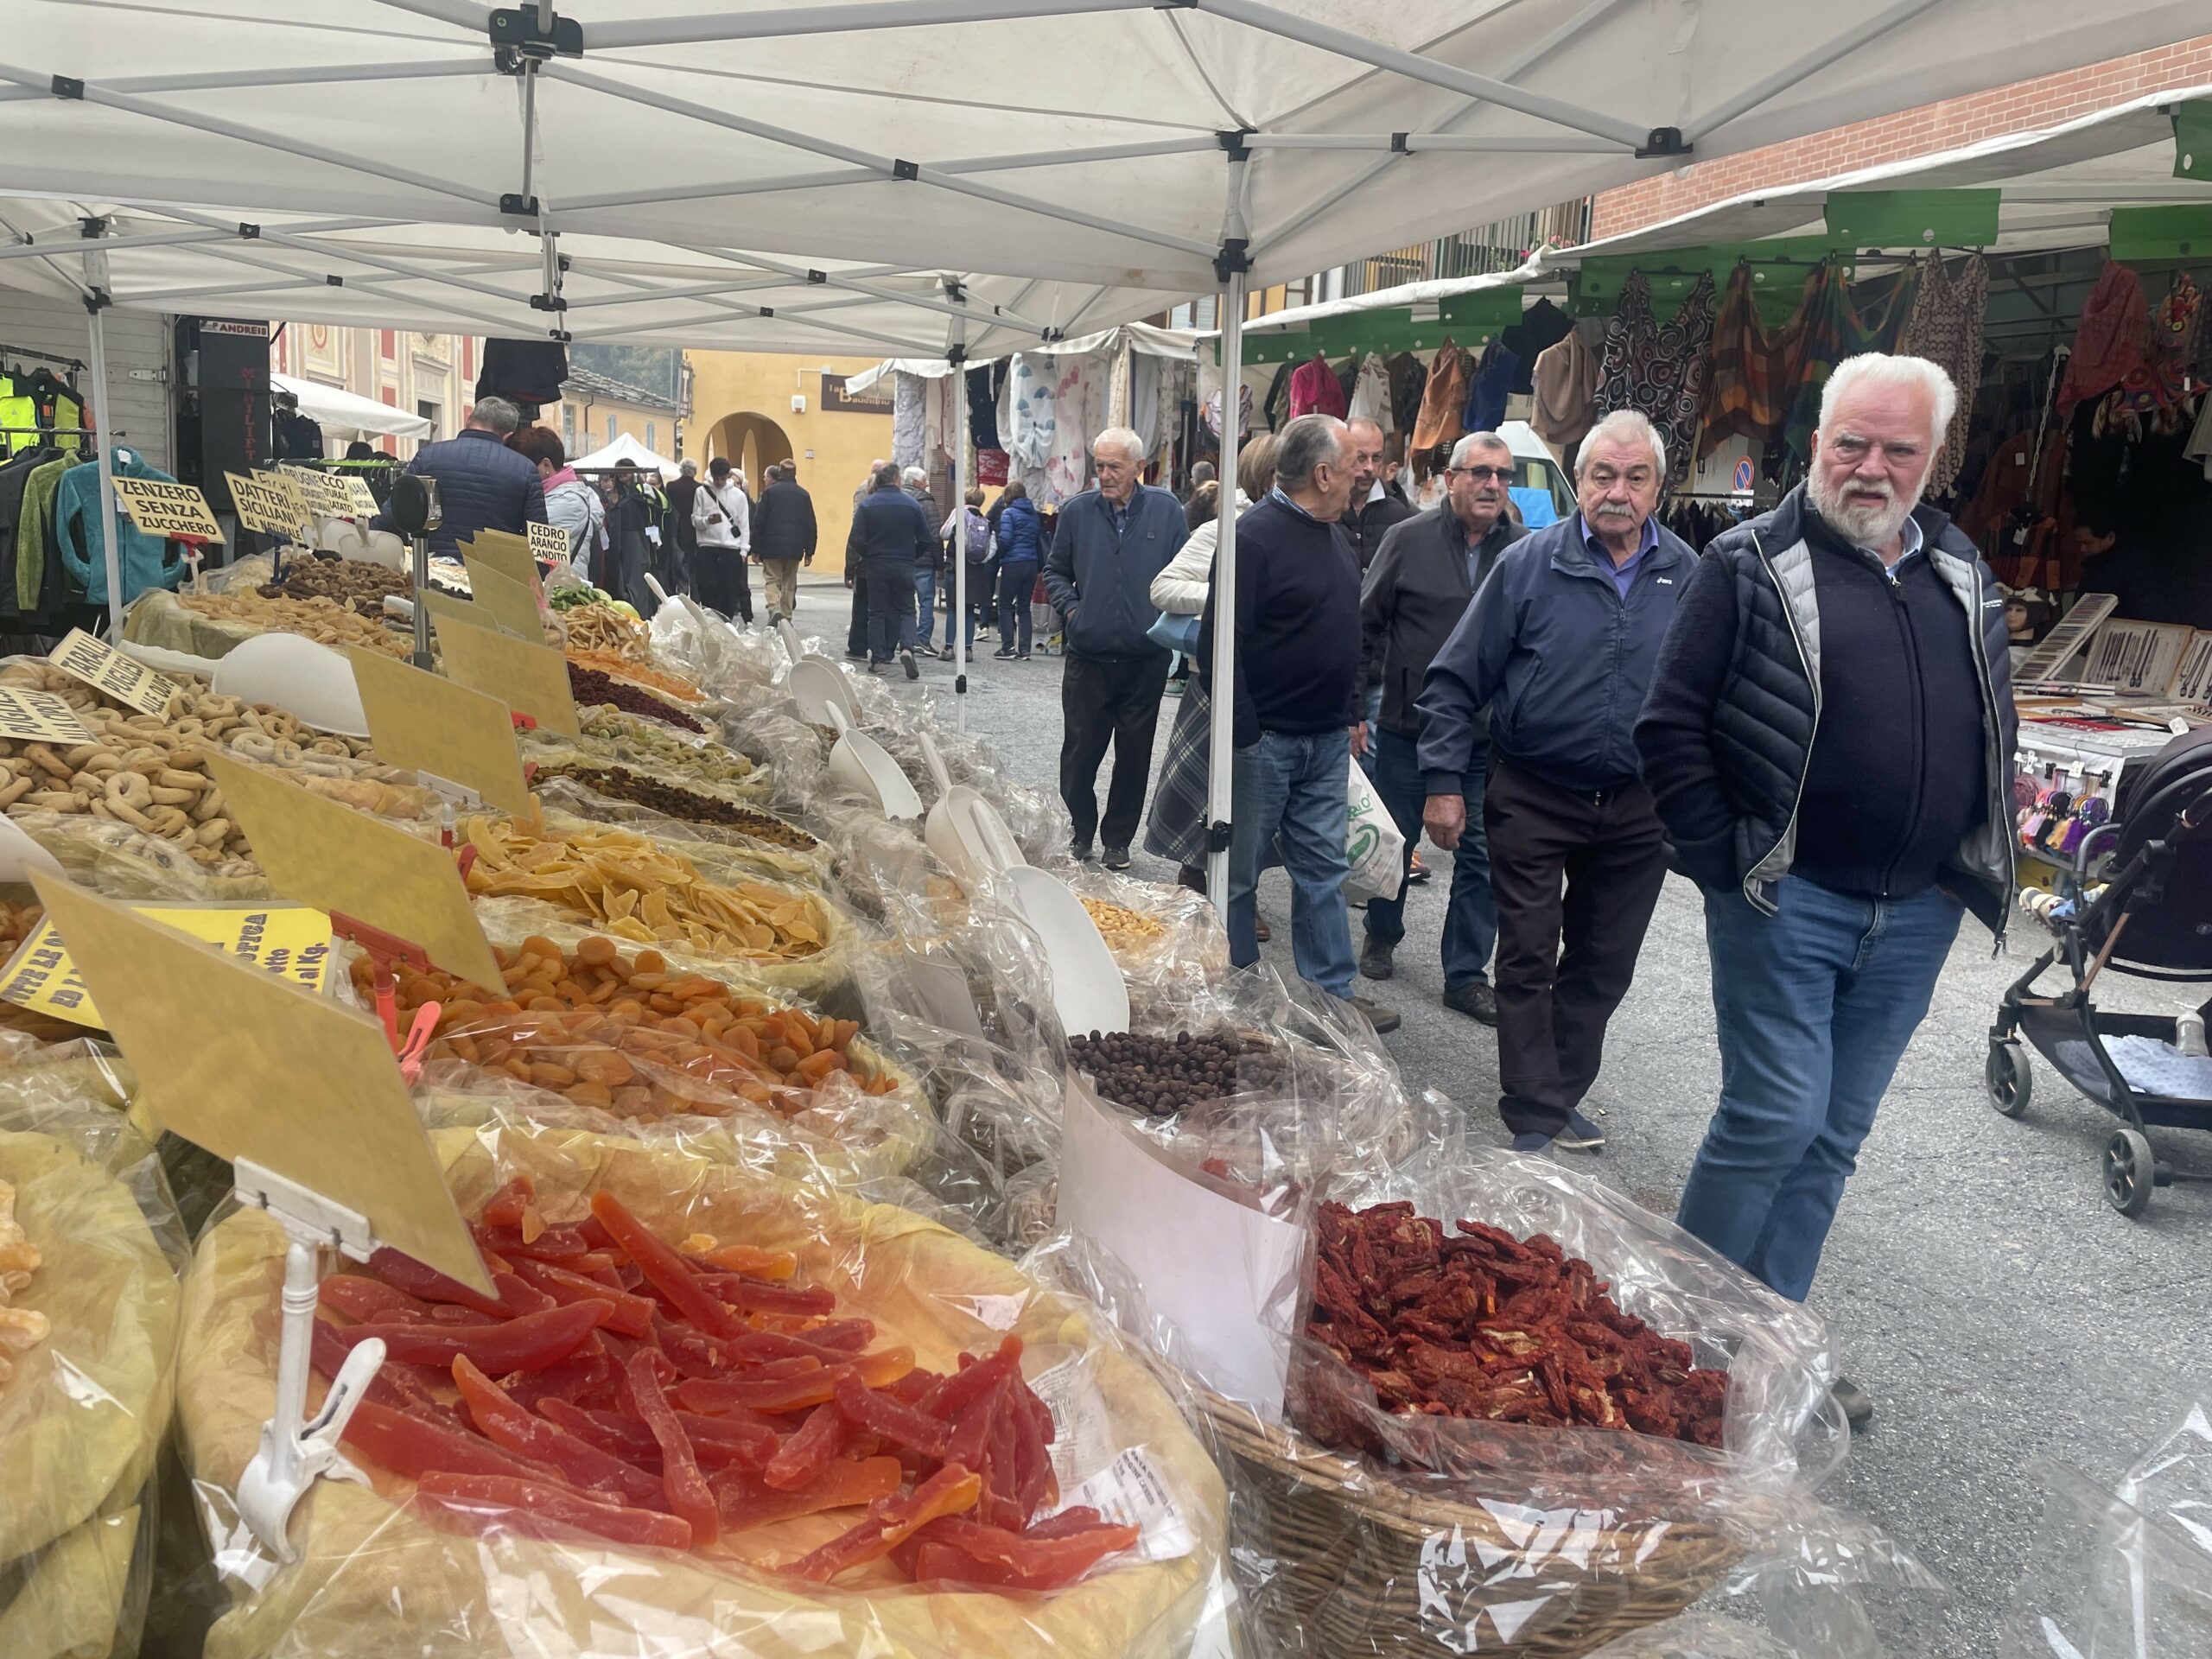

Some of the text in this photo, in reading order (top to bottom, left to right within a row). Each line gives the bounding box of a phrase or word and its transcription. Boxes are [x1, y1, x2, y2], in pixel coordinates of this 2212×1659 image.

[118, 480, 201, 503] ZENZERO
[321, 474, 345, 490] CCO
[232, 479, 291, 510] DATTERI
[136, 499, 207, 519] SENZA
[239, 498, 296, 525] SICILIANI
[138, 516, 218, 535] ZUCCHERO
[246, 516, 302, 540] AL NATURALE
[531, 524, 565, 540] CEDRO
[531, 536, 567, 552] ARANCIO
[531, 548, 567, 562] CANDITO
[60, 634, 112, 679] TARALLI
[101, 655, 145, 698] PUGLIESI
[138, 691, 166, 715] ALLE
[28, 949, 64, 969] LE
